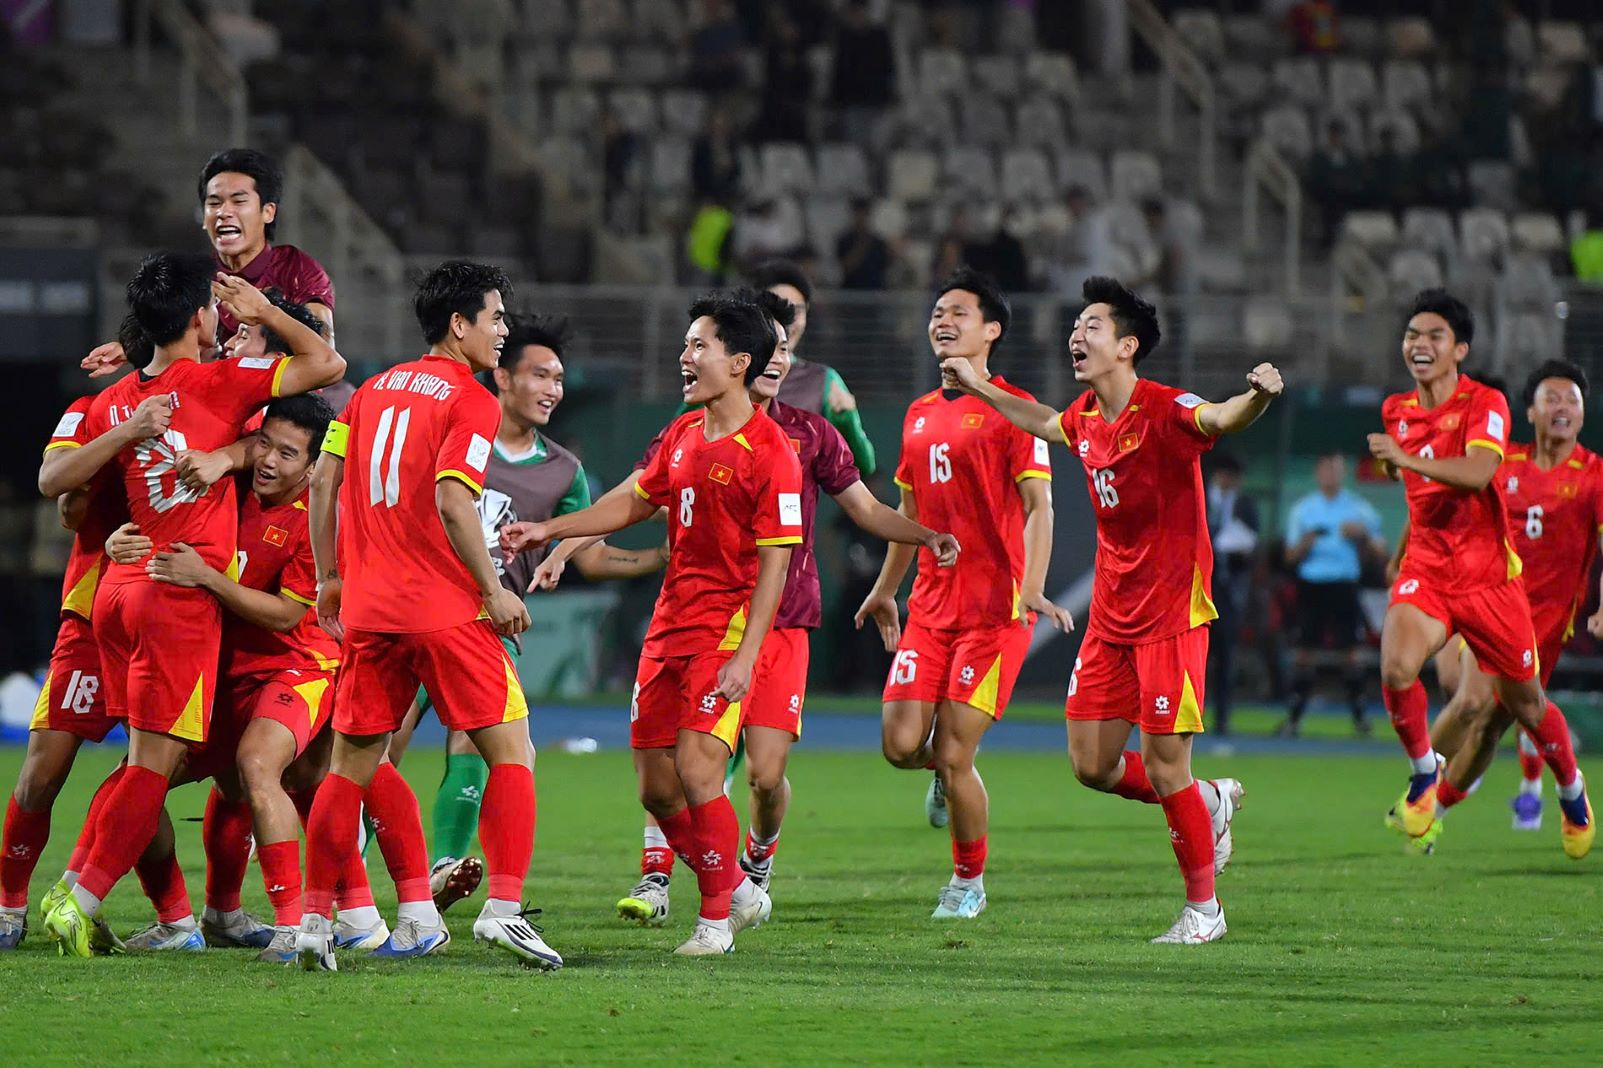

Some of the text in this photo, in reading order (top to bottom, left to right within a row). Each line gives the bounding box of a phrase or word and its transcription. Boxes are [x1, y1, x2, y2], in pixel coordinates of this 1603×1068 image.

[370, 404, 411, 508] 11
[929, 442, 952, 484] 15
[680, 487, 695, 528] 8
[1092, 468, 1119, 509] 16
[1526, 504, 1543, 540] 6
[890, 650, 919, 686] 15
[60, 670, 99, 714] 18
